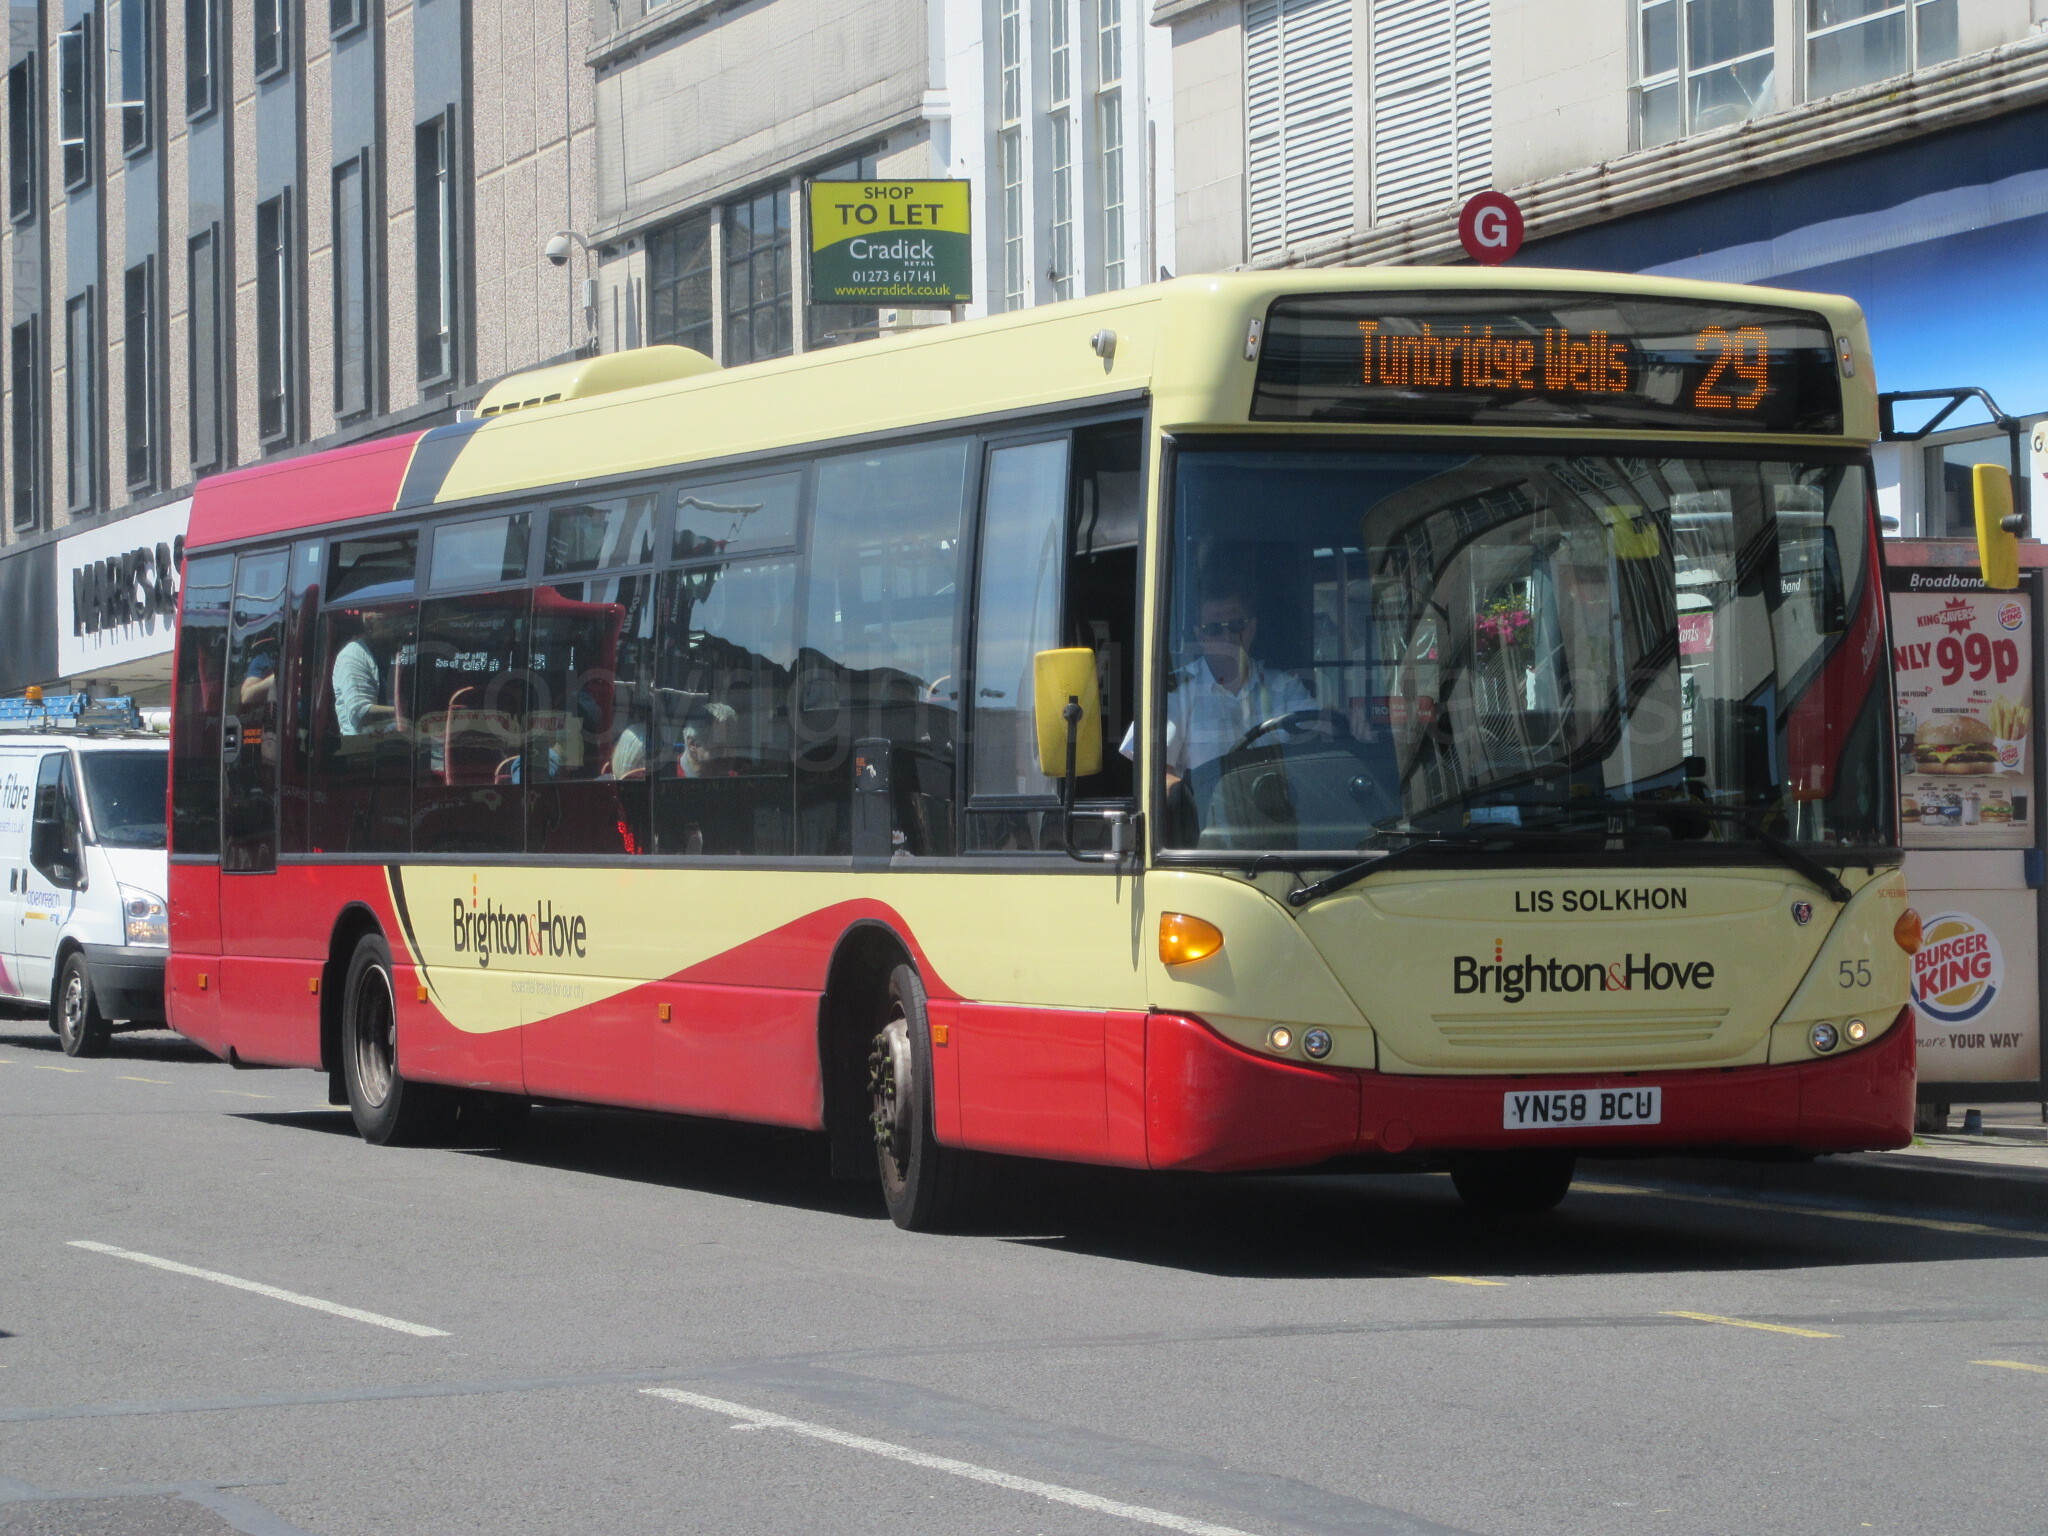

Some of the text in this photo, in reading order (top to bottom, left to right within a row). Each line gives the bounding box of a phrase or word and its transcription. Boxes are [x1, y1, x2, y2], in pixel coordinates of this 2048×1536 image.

[864, 186, 914, 199] SHOP
[835, 204, 944, 225] TO LET
[1474, 206, 1507, 247] G
[850, 239, 934, 260] Cradick
[852, 271, 936, 282] 01273 617141
[834, 284, 951, 296] www.cradick.co.uk
[1359, 321, 1768, 410] Tunbridge Wells 29
[1917, 608, 1975, 627] KING SAVERS
[2000, 607, 2021, 617] BURGER
[2000, 612, 2023, 625] KING
[1895, 642, 1932, 673] NLY
[1936, 632, 2019, 686] 99p
[2, 773, 30, 810] fibre
[26, 889, 61, 908] openreach
[1515, 887, 1688, 913] LIS SOLKHON
[1914, 933, 1988, 974] BURGER
[1453, 938, 1715, 1003] Brighton&Hove
[1839, 958, 1872, 988] 55
[1918, 951, 1992, 1001] KING
[1916, 1033, 2020, 1049] more YOUR WAY
[1514, 1091, 1652, 1123] YN58 BCU
